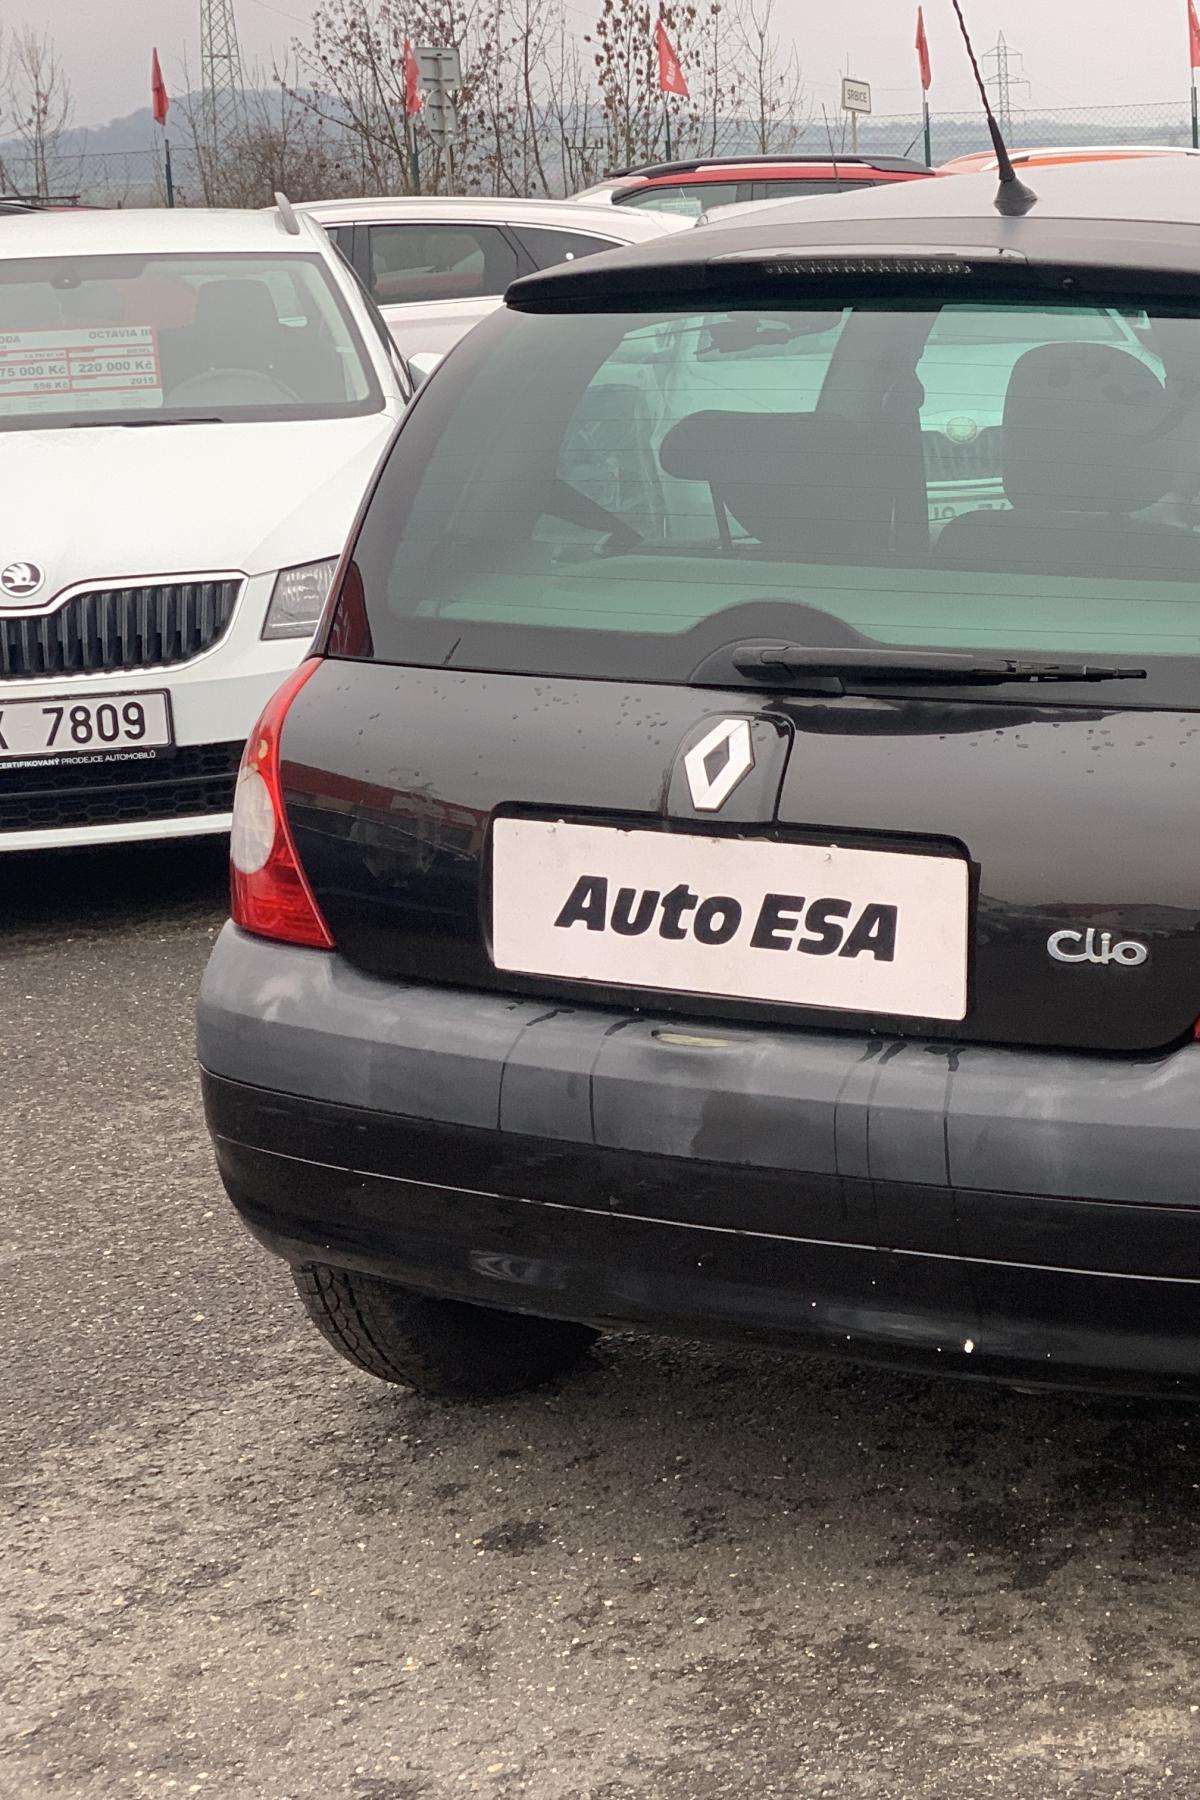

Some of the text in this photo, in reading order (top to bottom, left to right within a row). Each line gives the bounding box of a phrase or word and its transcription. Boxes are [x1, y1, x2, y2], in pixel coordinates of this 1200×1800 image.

[88, 330, 138, 339] OCTAVIA
[19, 366, 45, 377] 000
[48, 363, 67, 375] Kč
[78, 359, 153, 374] 220 000 Kč
[42, 701, 146, 746] 7809
[61, 755, 104, 765] PRODEJCE
[105, 750, 156, 762] AUTOMOBILŮ
[554, 875, 899, 963] Auto ESA
[1046, 927, 1148, 966] Clio
